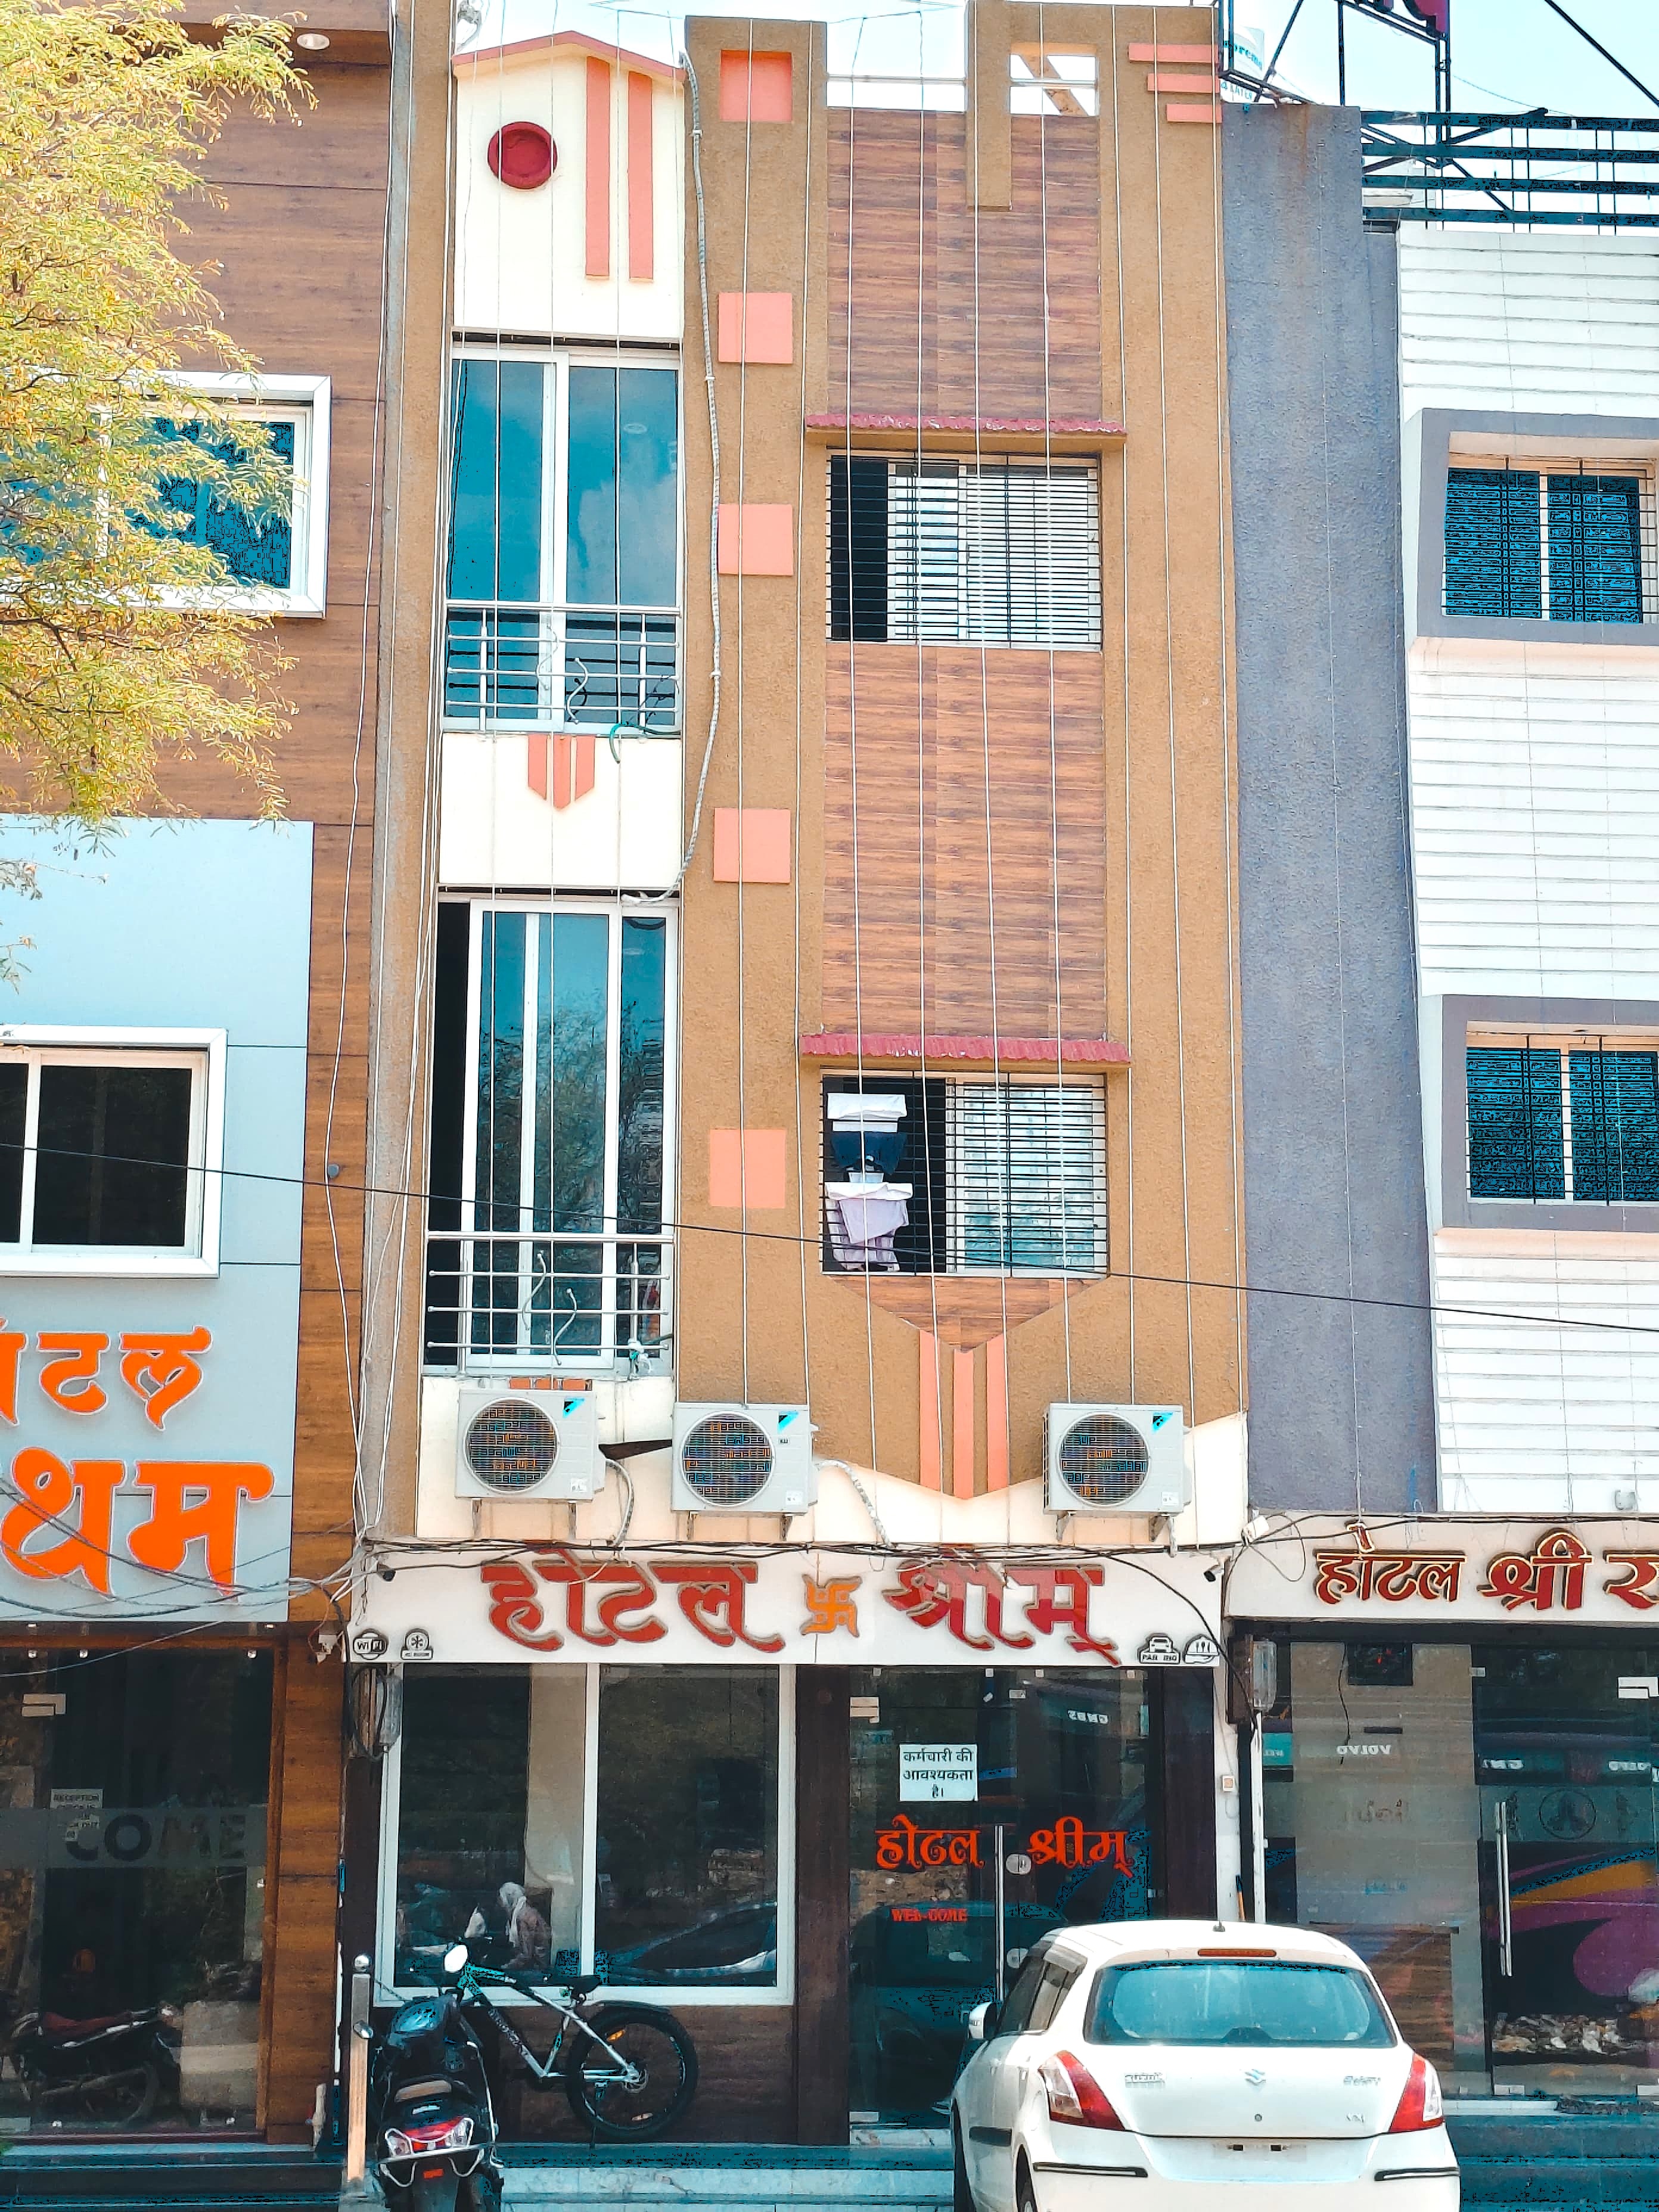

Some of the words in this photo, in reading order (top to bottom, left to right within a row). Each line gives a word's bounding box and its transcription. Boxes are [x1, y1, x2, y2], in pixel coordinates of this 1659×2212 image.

[1313, 1521, 1467, 1605] होटल
[1477, 1527, 1594, 1611] श्री
[480, 1539, 785, 1653] होटल
[903, 1747, 952, 1762] कर्मचारी
[955, 1747, 974, 1762] की
[903, 1769, 973, 1781] आवश्यकता
[875, 1813, 986, 1869] होटल
